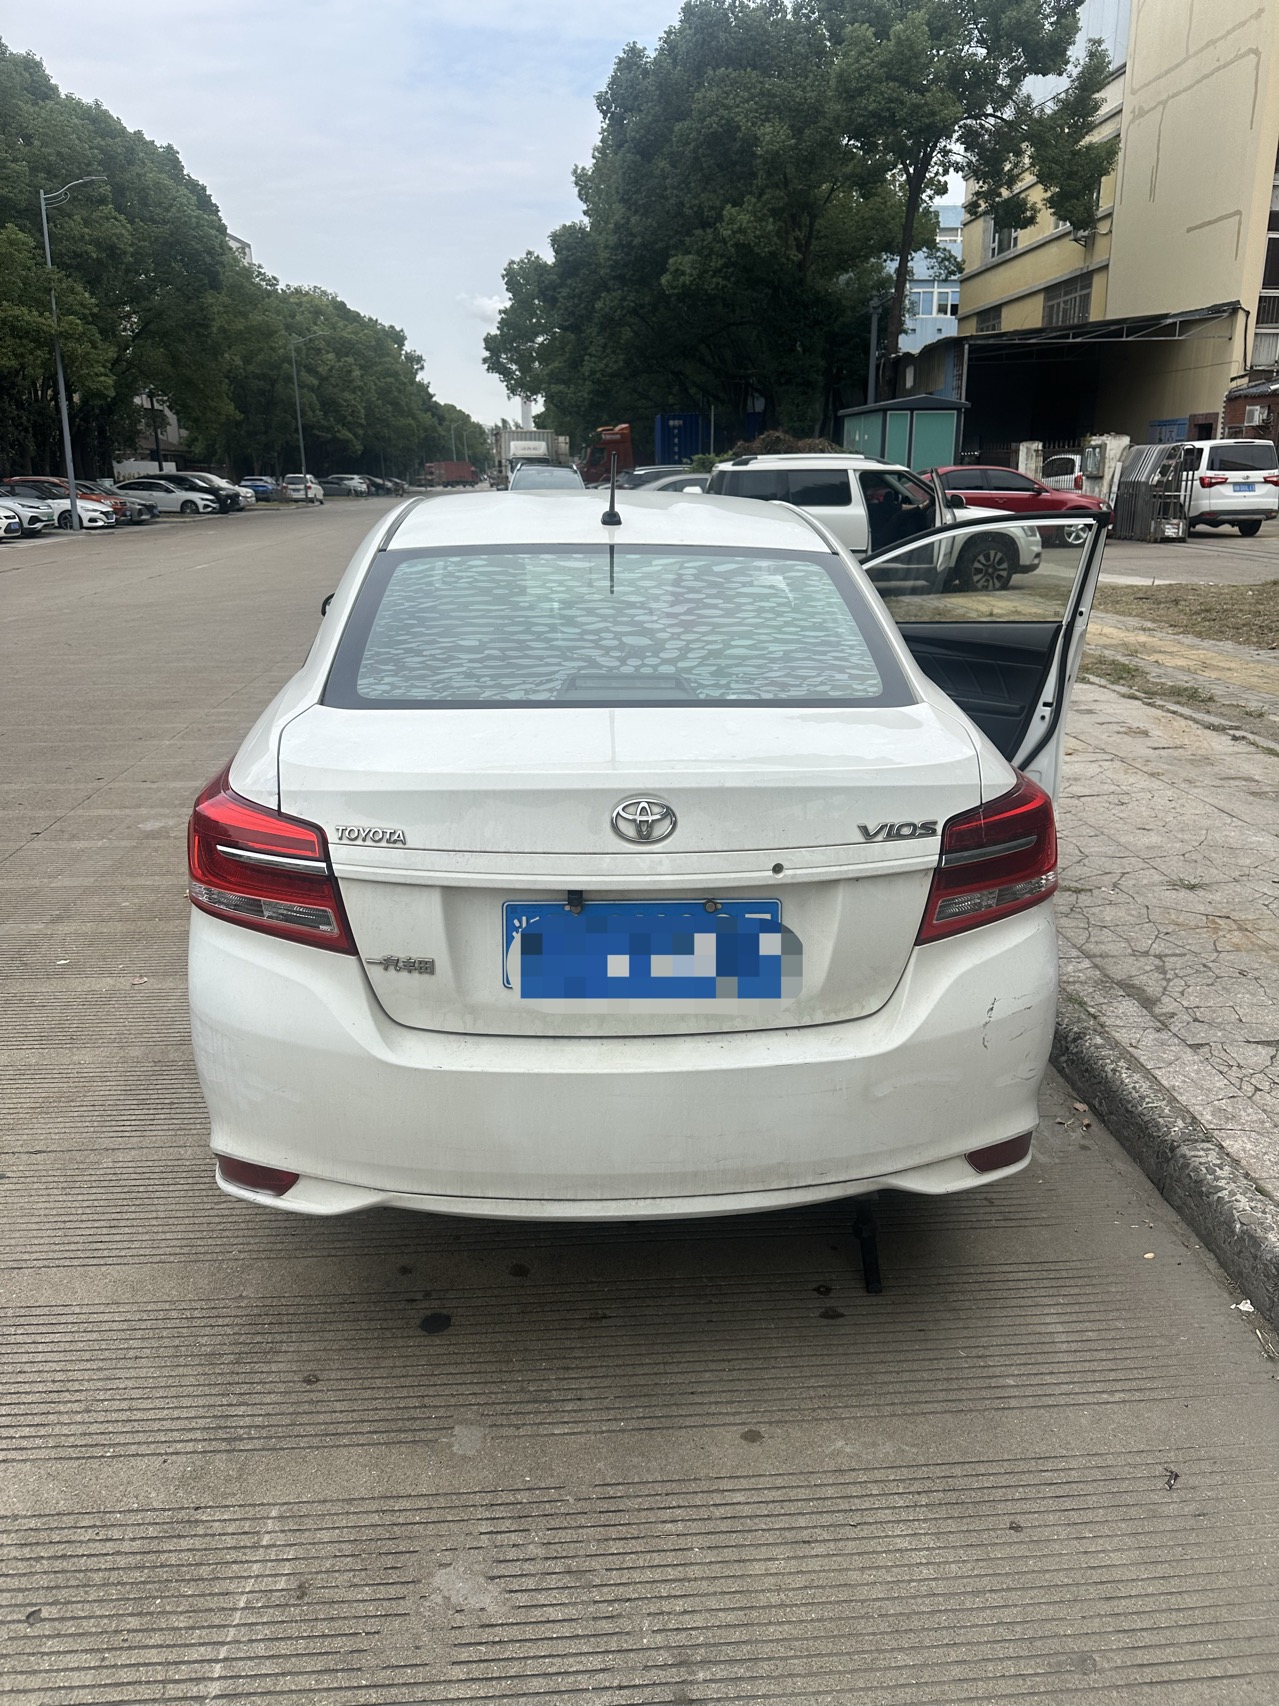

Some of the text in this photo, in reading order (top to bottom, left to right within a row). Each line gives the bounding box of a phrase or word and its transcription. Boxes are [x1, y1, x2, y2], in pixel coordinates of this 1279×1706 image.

[335, 825, 406, 845] TOYOTA
[857, 820, 938, 840] VIOS
[365, 954, 435, 975] 一汽丰田
